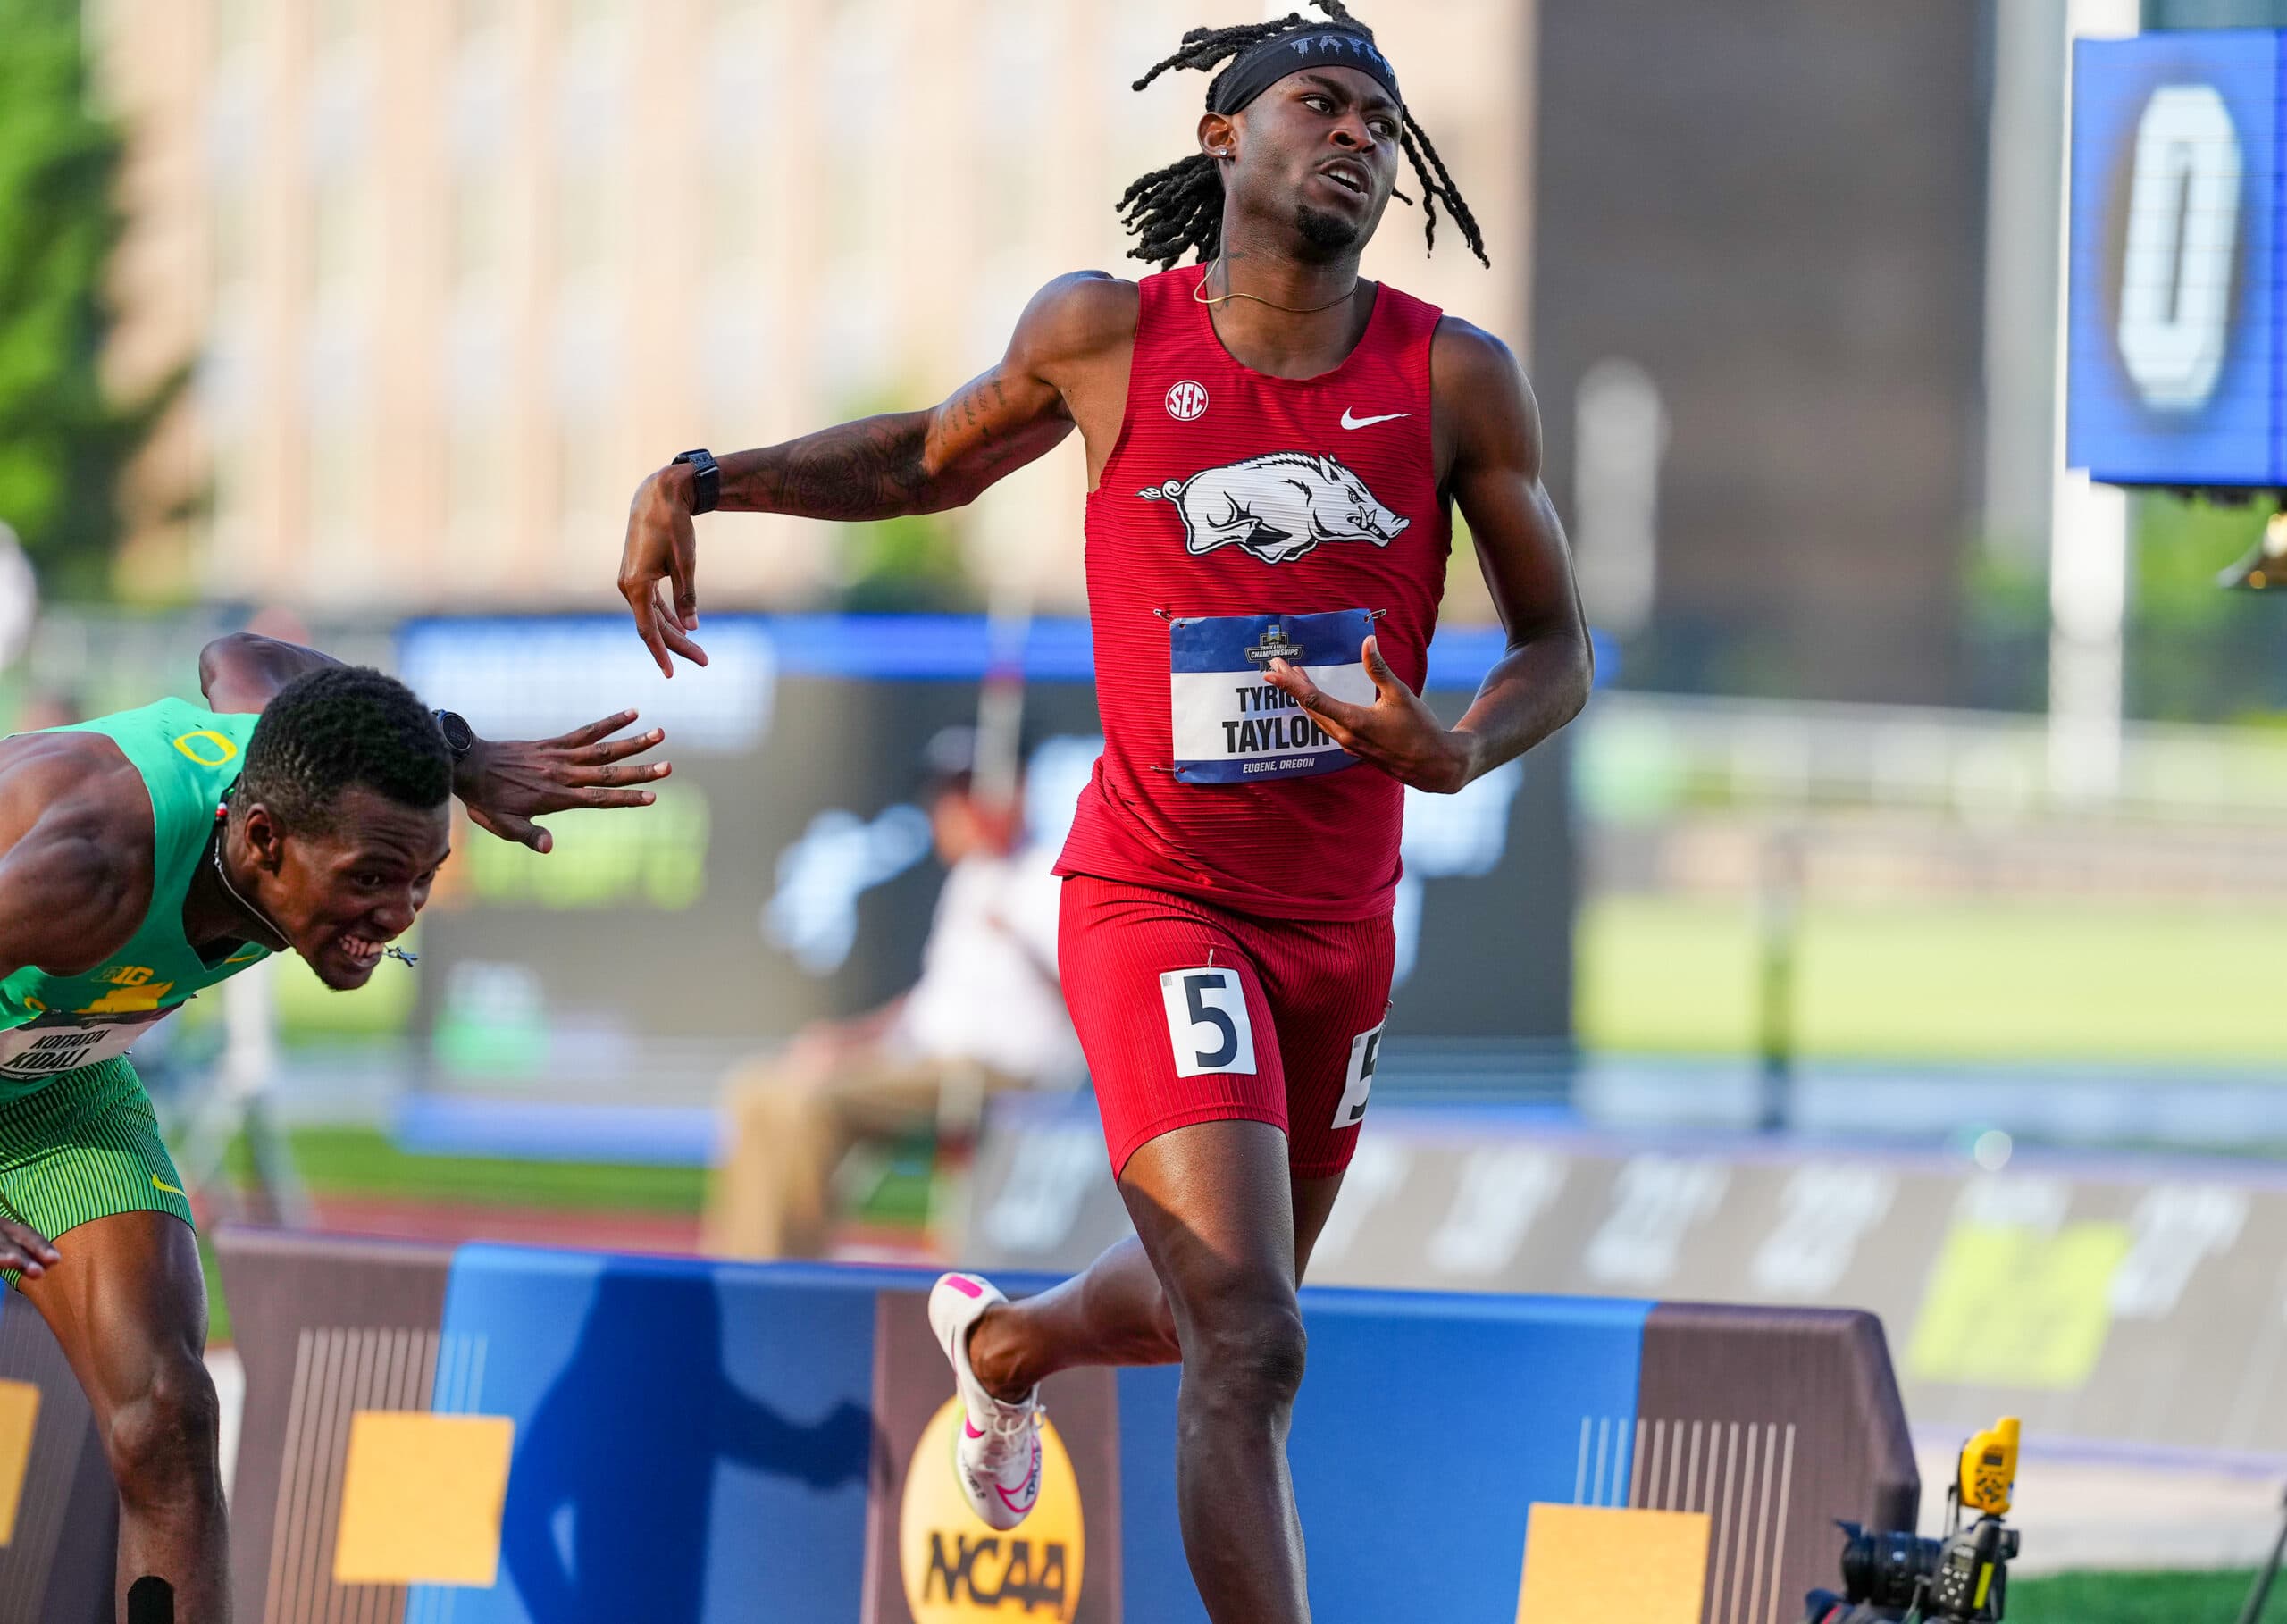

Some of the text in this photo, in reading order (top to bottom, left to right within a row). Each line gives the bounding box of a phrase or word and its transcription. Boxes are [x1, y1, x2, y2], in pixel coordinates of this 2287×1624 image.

[1169, 382, 1205, 418] SEC
[1251, 649, 1299, 658] CHAMPIONSHIPS
[1243, 758, 1315, 774] EUGENE, OREGON
[1184, 974, 1238, 1067] 5
[4, 1049, 90, 1069] KIDALI
[924, 1532, 1065, 1620] NCAA
